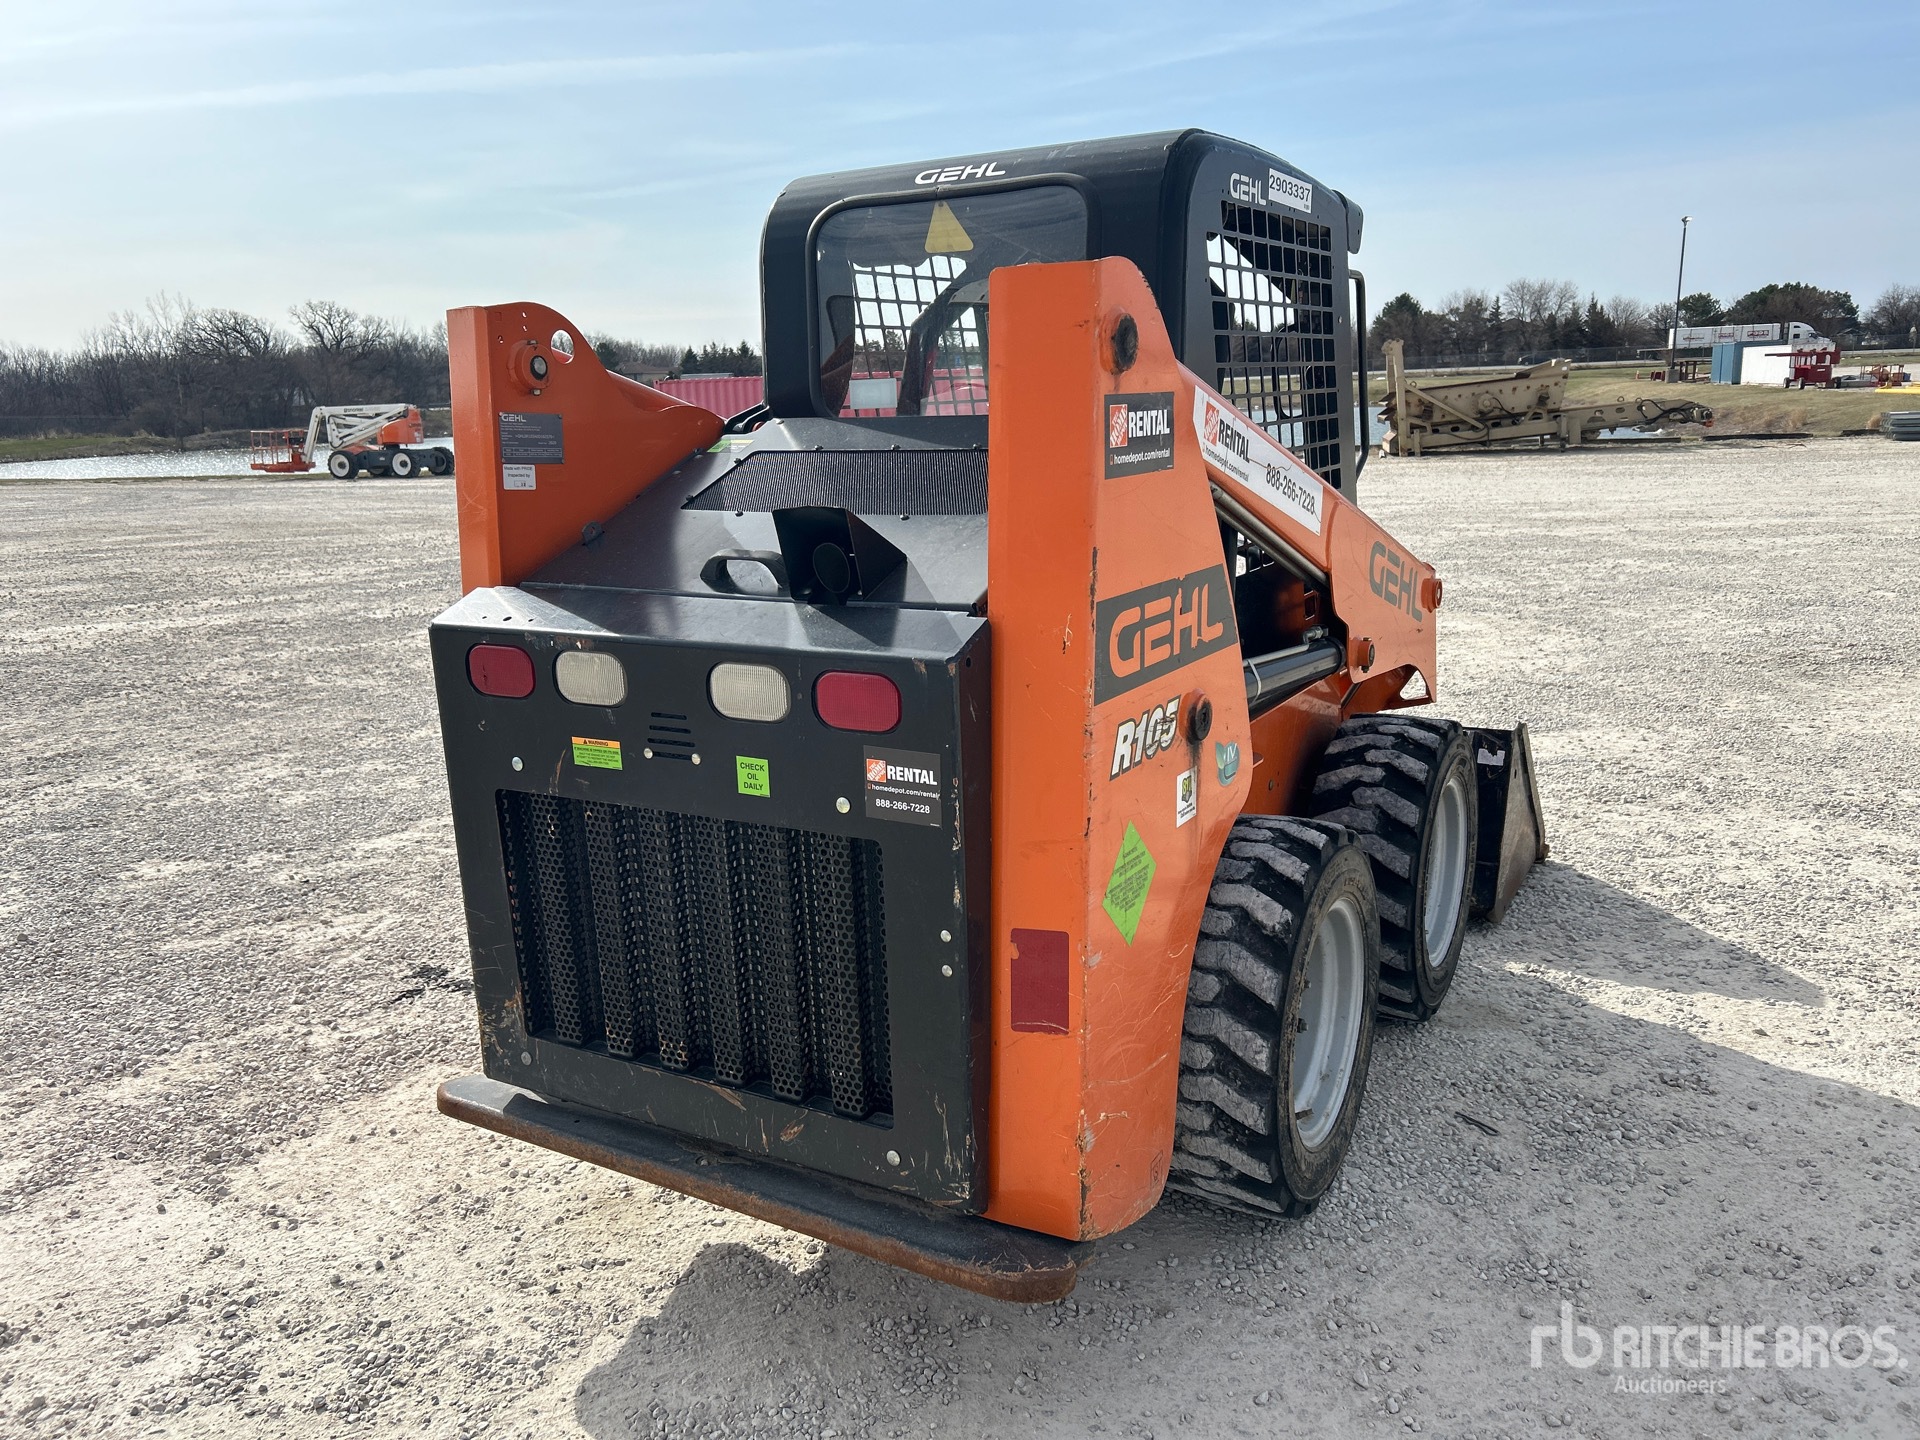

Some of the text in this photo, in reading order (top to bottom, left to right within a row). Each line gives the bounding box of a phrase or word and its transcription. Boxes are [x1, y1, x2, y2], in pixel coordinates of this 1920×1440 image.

[914, 161, 1006, 185] GEHL
[1229, 172, 1267, 206] GEHL
[1269, 174, 1311, 202] 2903337
[501, 414, 526, 422] GEHL
[1128, 409, 1171, 438] RENTAL
[1218, 418, 1250, 464] RENTAL
[1113, 447, 1171, 465] homedepot.com/rental
[1265, 463, 1316, 515] 888-266-7228
[1369, 540, 1423, 623] GEHL
[1109, 583, 1224, 678] GEHL
[1109, 694, 1182, 782] R105
[740, 762, 765, 772] CHECK
[746, 772, 759, 781] OIL
[886, 764, 938, 786] RENTAL
[743, 781, 764, 791] DAILY
[871, 783, 939, 799] homedepot.com/rental
[875, 798, 931, 814] 888-266-7228
